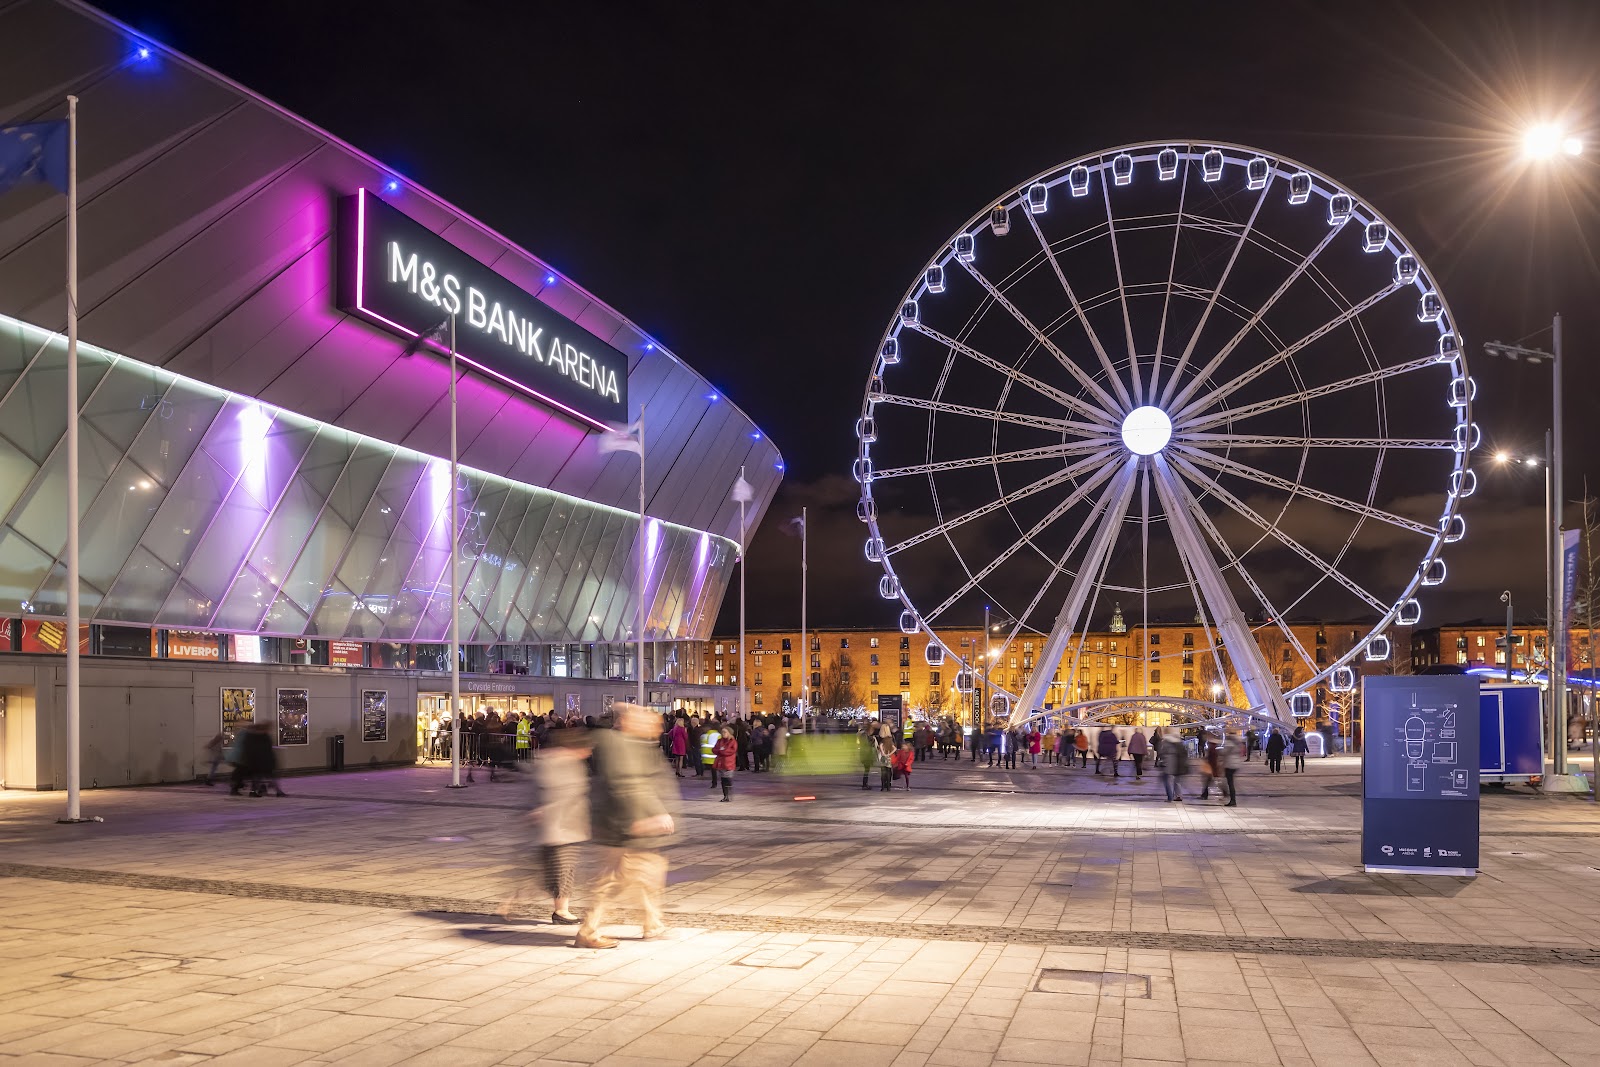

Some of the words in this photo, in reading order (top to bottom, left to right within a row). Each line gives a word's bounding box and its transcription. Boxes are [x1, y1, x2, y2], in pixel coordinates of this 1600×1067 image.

[388, 241, 460, 315] M&S
[467, 286, 544, 363] BANK
[548, 337, 620, 404] ARENA
[468, 681, 491, 692] Cityside
[492, 682, 516, 692] Entrance
